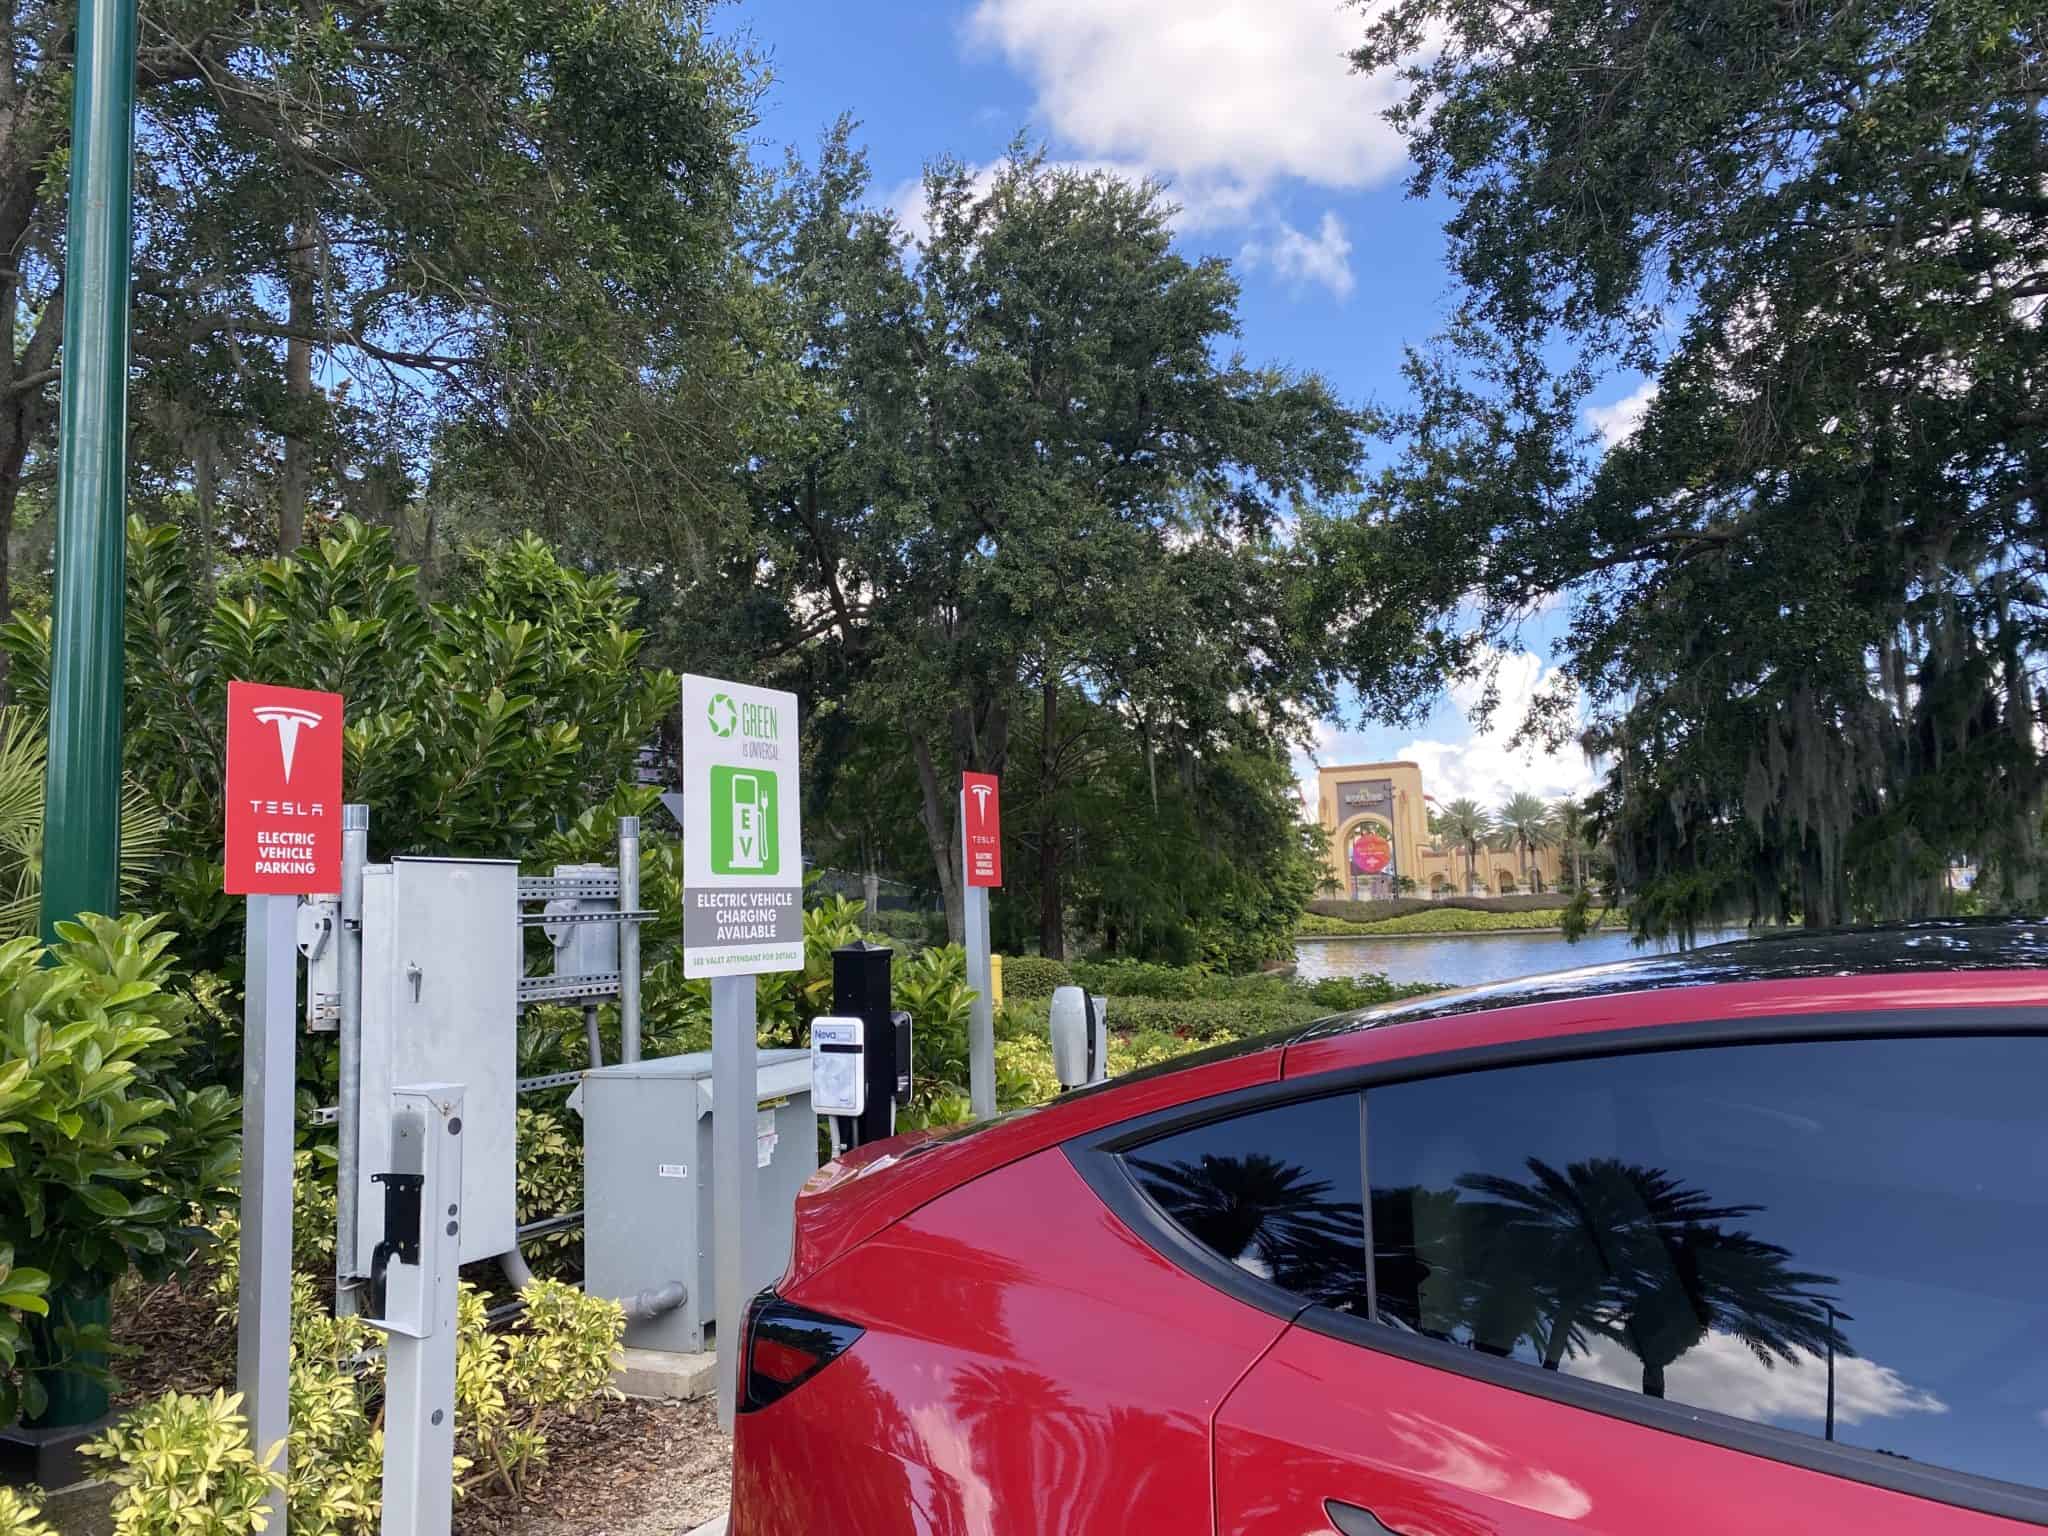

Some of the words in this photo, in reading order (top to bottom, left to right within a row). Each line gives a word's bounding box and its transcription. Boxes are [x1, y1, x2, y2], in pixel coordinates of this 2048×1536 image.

[742, 703, 778, 740] GREEN
[250, 800, 323, 816] TESLA
[257, 832, 315, 846] ELECTRIC
[259, 847, 313, 860] VEHICLE
[255, 861, 316, 875] PARKING
[697, 893, 748, 908] ELECTRIC
[749, 892, 793, 906] VEHICLE
[716, 908, 777, 924] CHARGING
[717, 924, 777, 940] AVAILABLE
